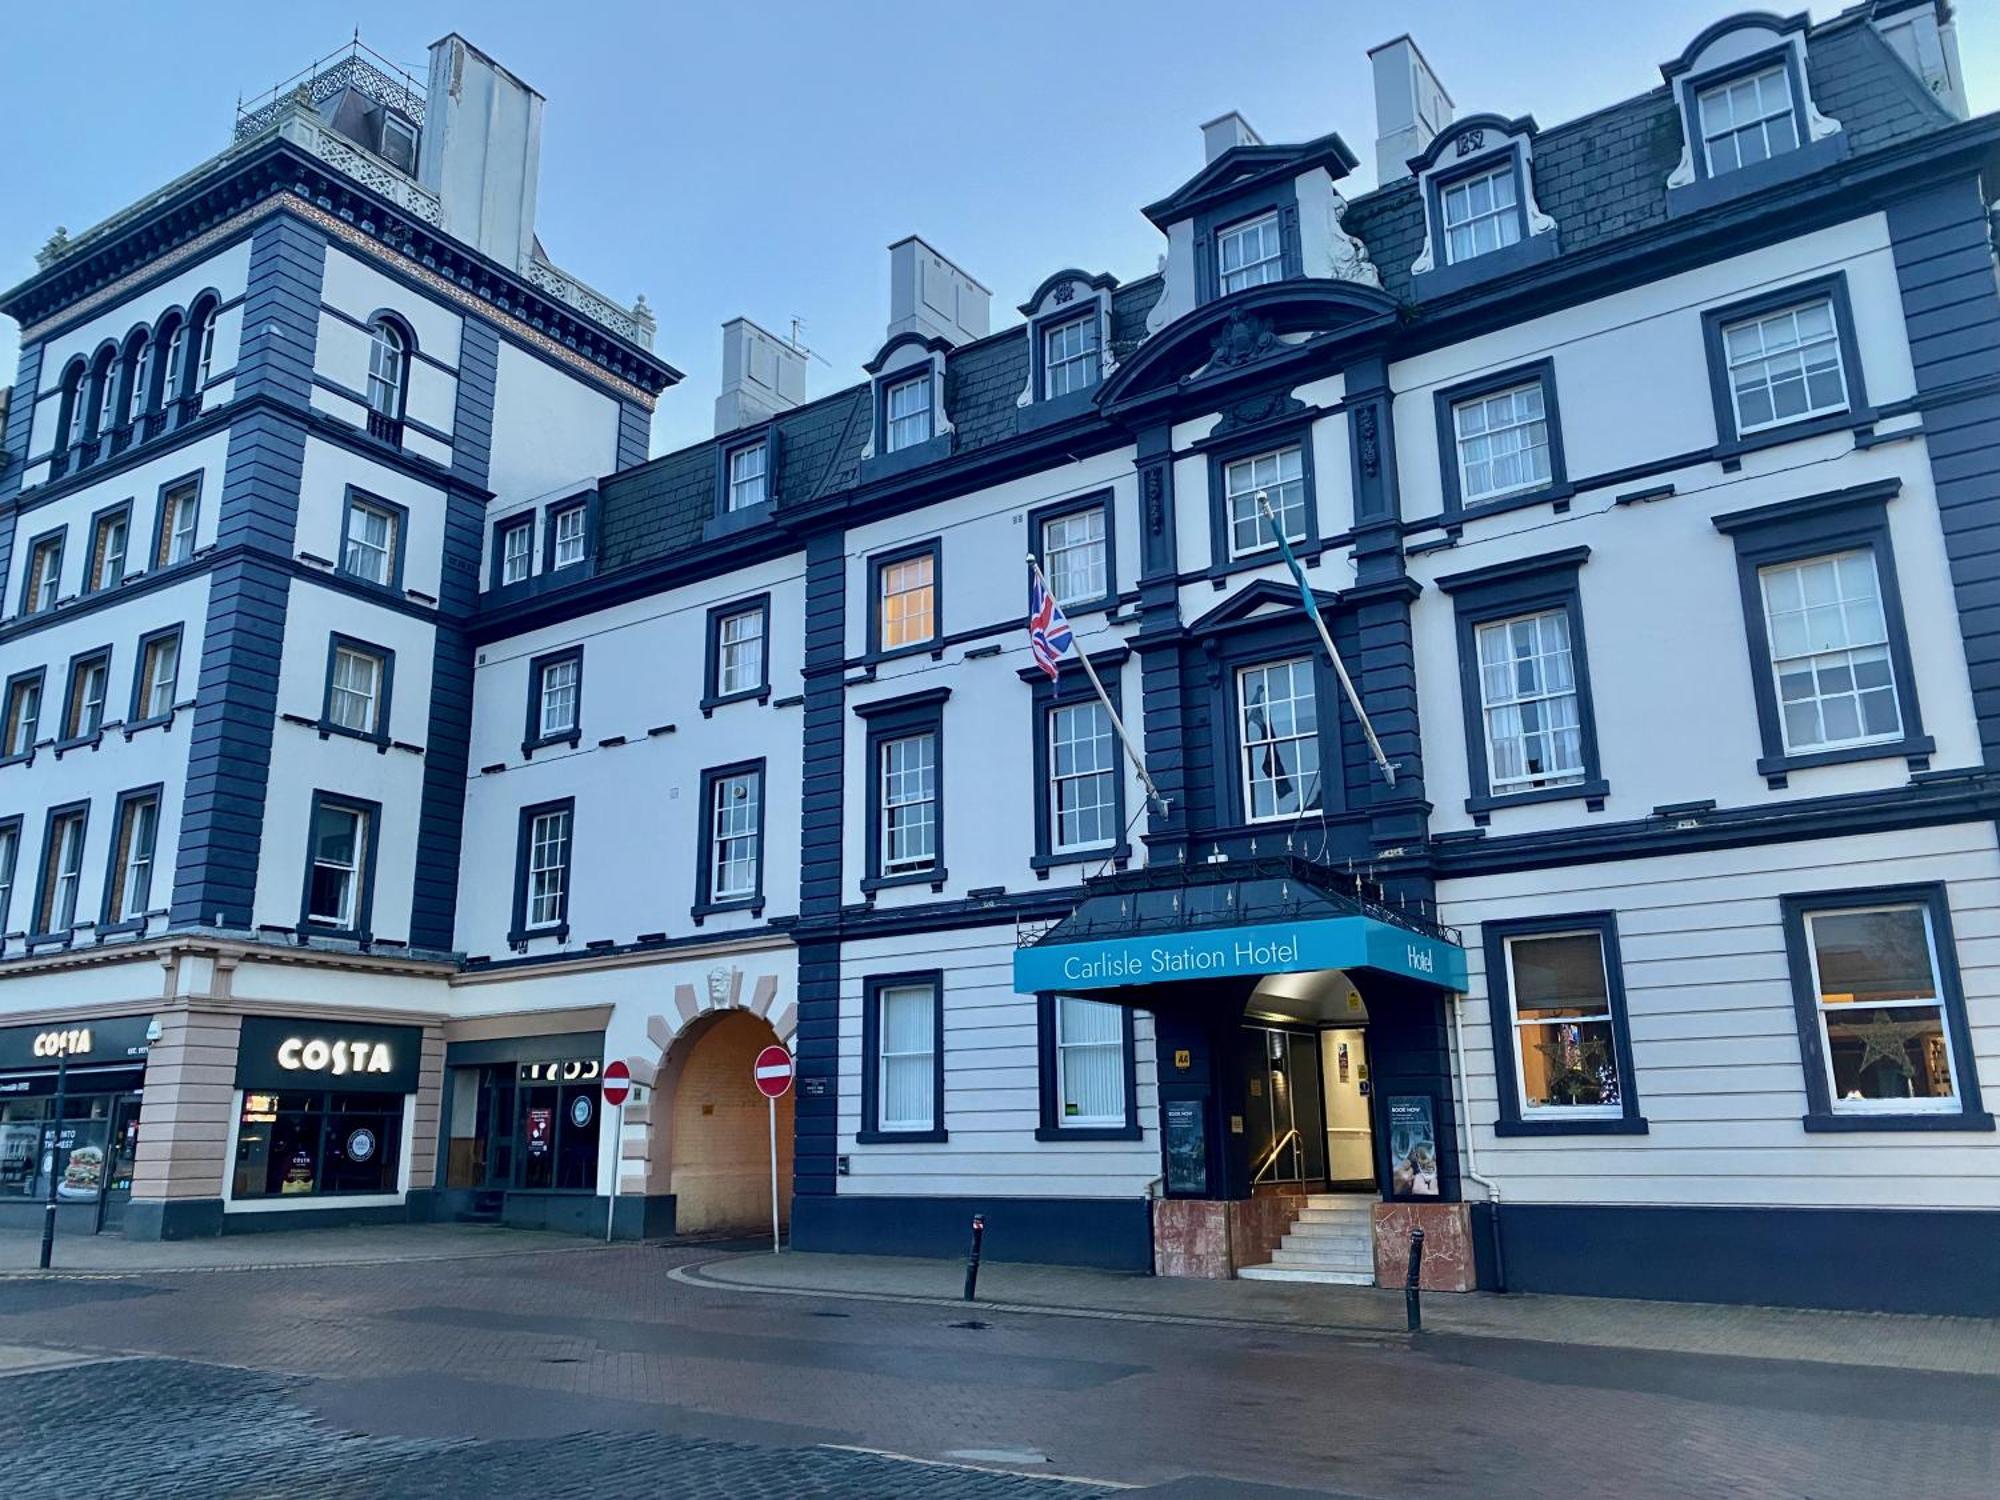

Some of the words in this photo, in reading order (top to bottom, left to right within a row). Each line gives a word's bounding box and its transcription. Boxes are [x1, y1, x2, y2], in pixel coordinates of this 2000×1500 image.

[1063, 950, 1142, 980] Carlisle
[1151, 946, 1225, 973] Station
[1235, 935, 1299, 966] Hotel
[1407, 944, 1433, 973] Hotel
[33, 1029, 92, 1057] COSTA
[277, 1037, 392, 1075] COSTA
